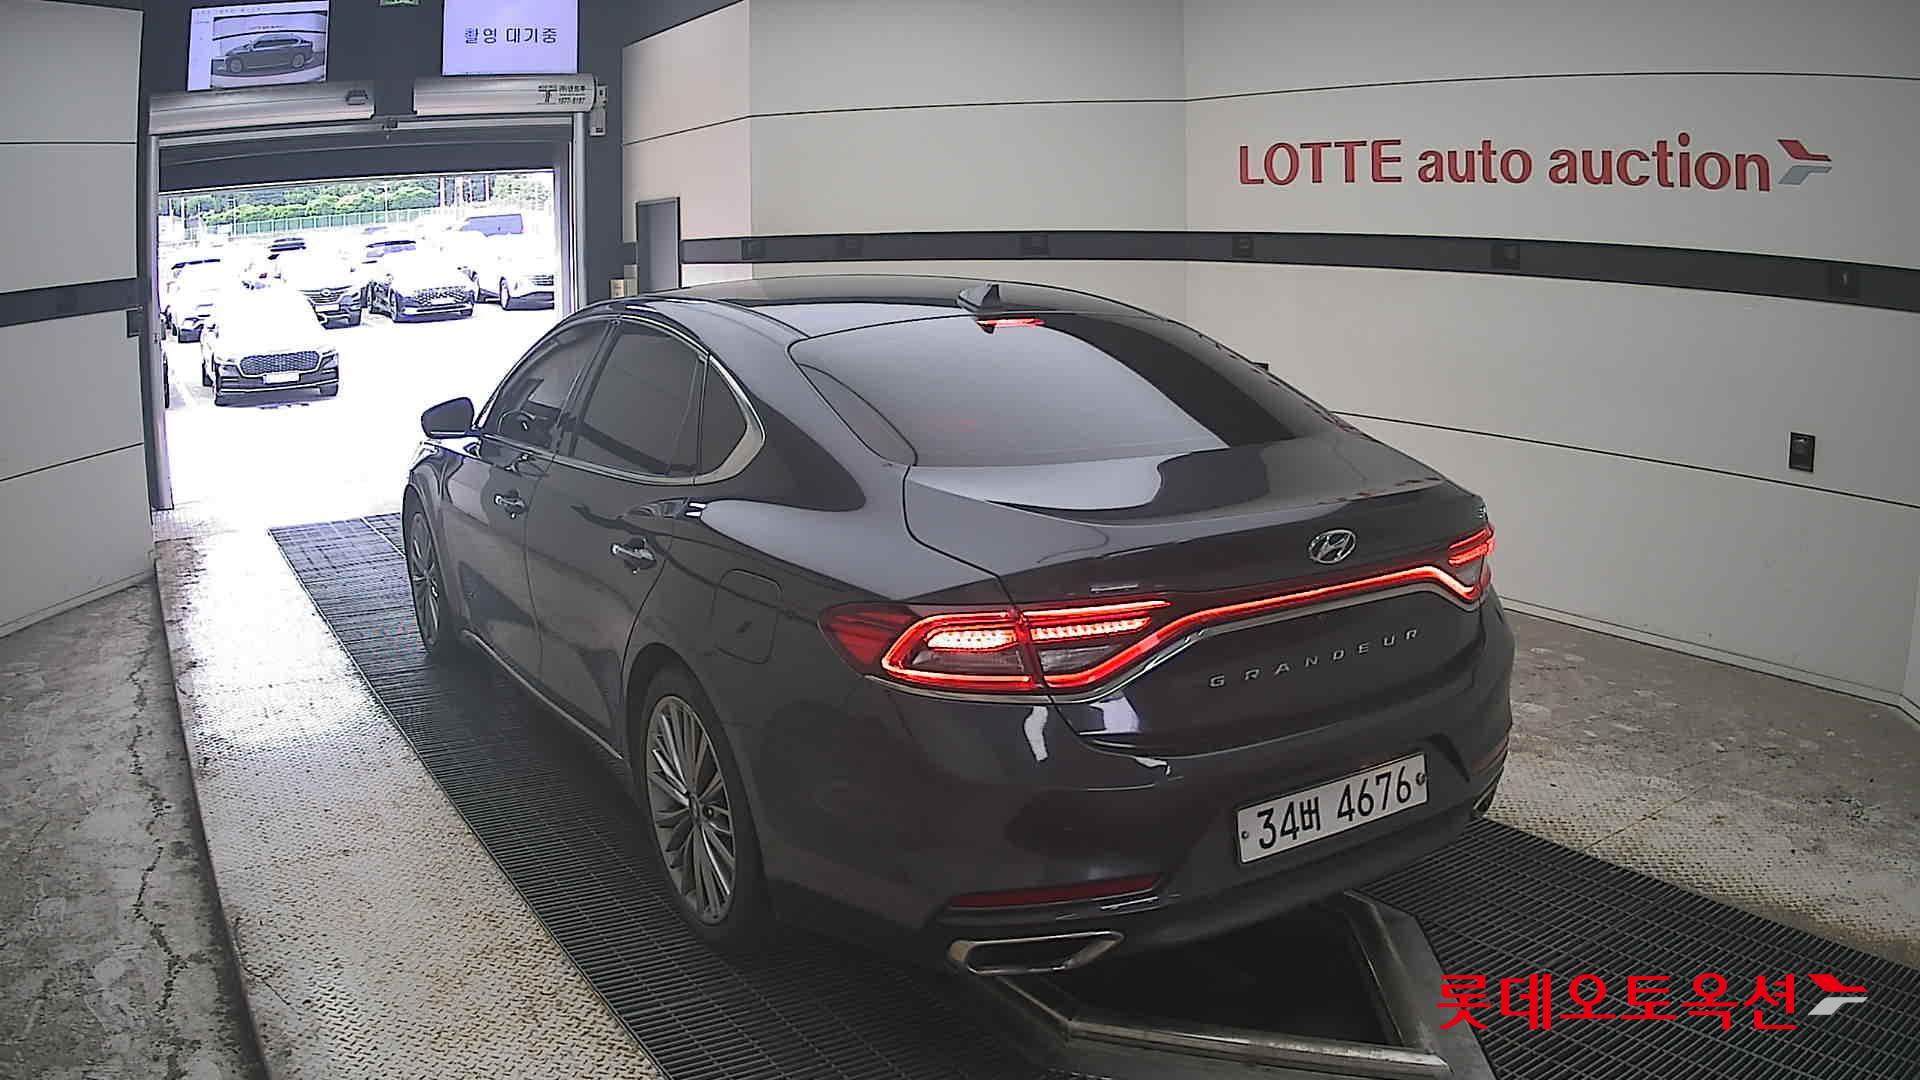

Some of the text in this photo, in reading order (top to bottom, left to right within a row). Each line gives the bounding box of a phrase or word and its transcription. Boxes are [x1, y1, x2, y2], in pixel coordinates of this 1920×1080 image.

[464, 27, 557, 44] 촬영 대기중
[1239, 132, 1771, 192] LOTTE auto auction
[1209, 629, 1418, 689] GRANDEUR
[1257, 765, 1412, 849] 34버 4676
